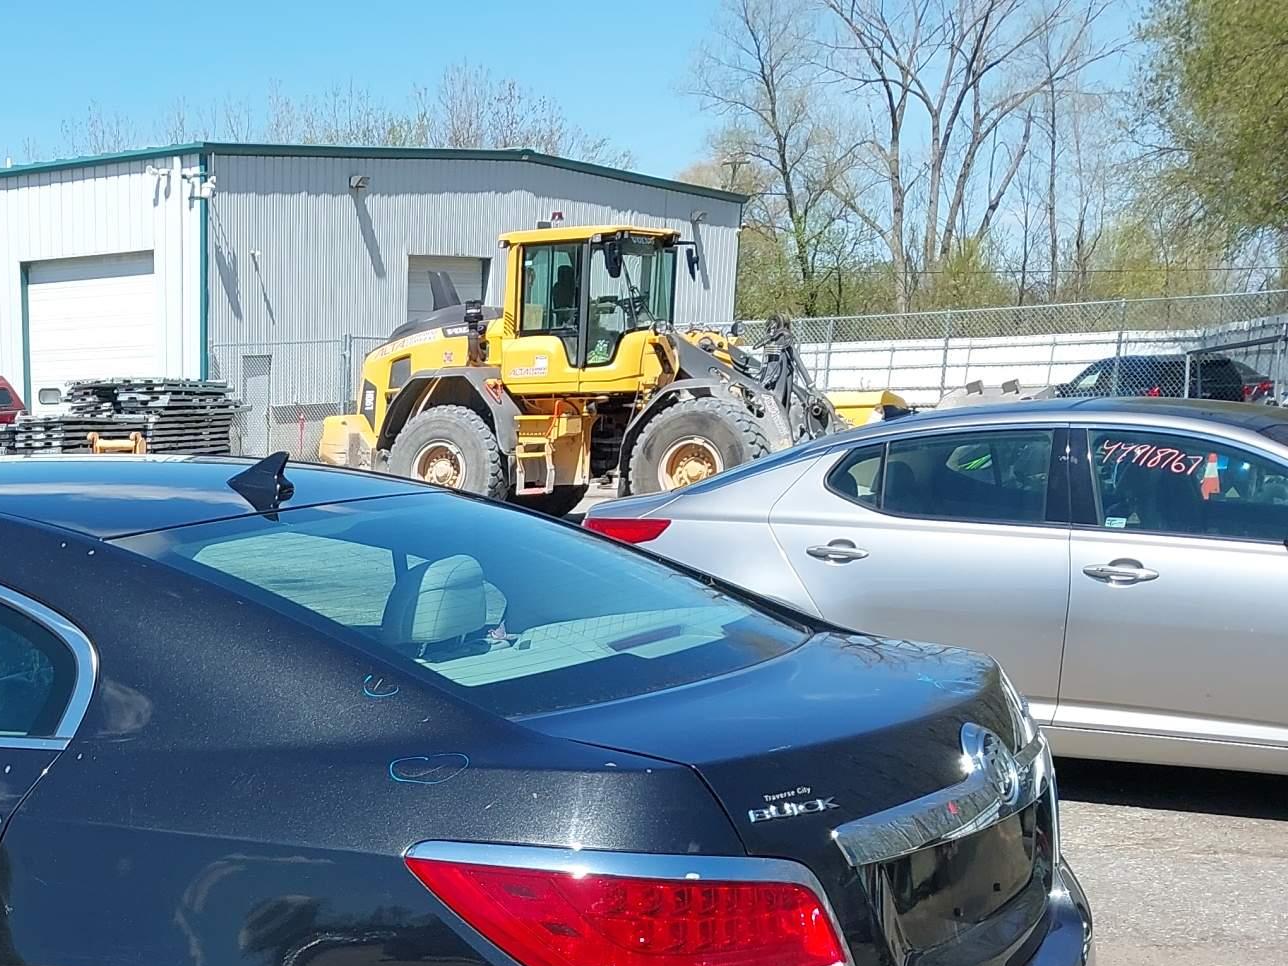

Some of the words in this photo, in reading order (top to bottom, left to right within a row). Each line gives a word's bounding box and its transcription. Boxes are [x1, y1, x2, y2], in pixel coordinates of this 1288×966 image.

[1102, 440, 1203, 475] 44918767
[763, 790, 795, 802] Traverse
[796, 785, 811, 795] City
[748, 796, 841, 823] BUICK
